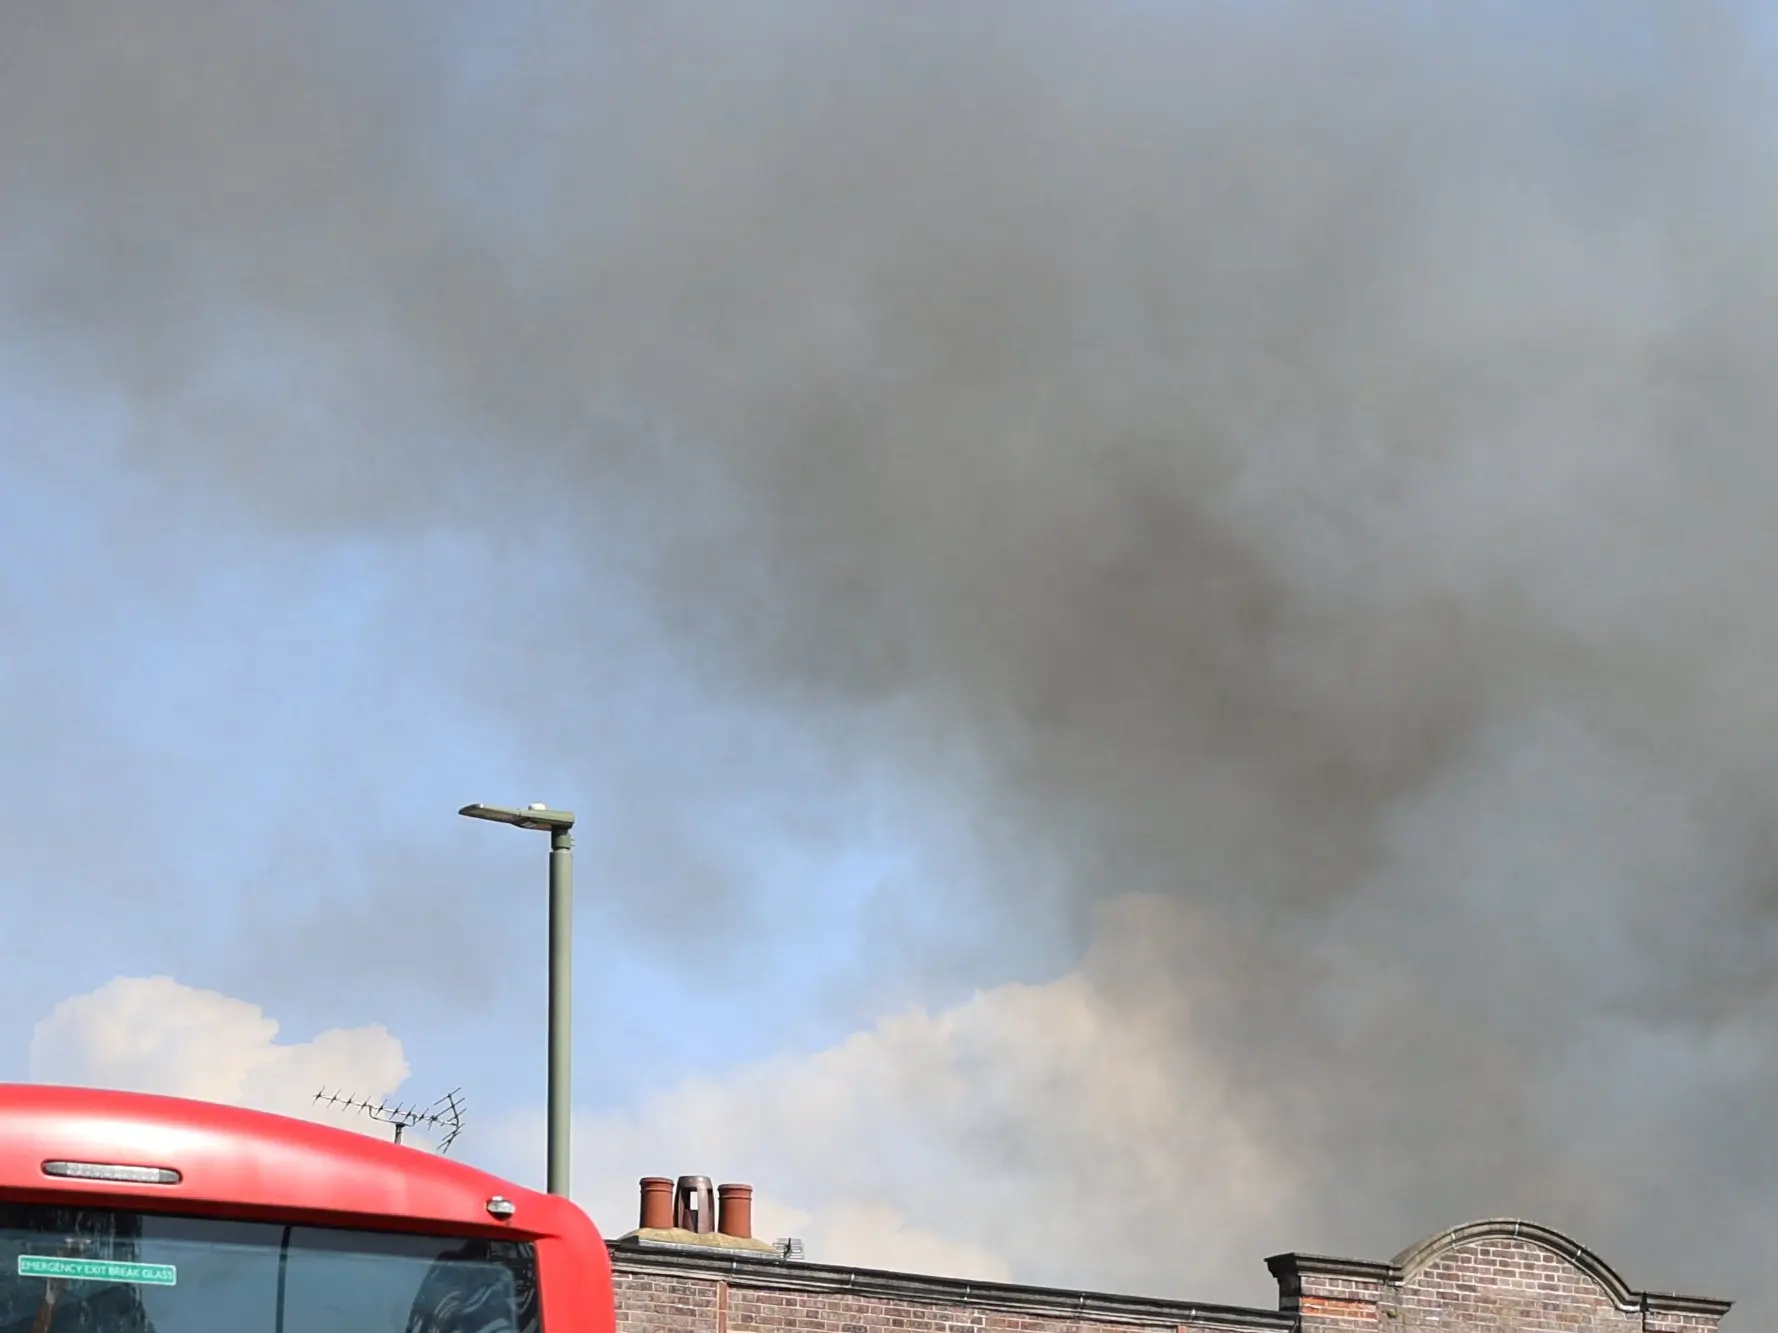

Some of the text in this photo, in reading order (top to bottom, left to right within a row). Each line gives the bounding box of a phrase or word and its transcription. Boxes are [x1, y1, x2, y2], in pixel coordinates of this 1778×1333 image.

[21, 1260, 174, 1280] EMERGENCY EXIT BREAK GLASS
